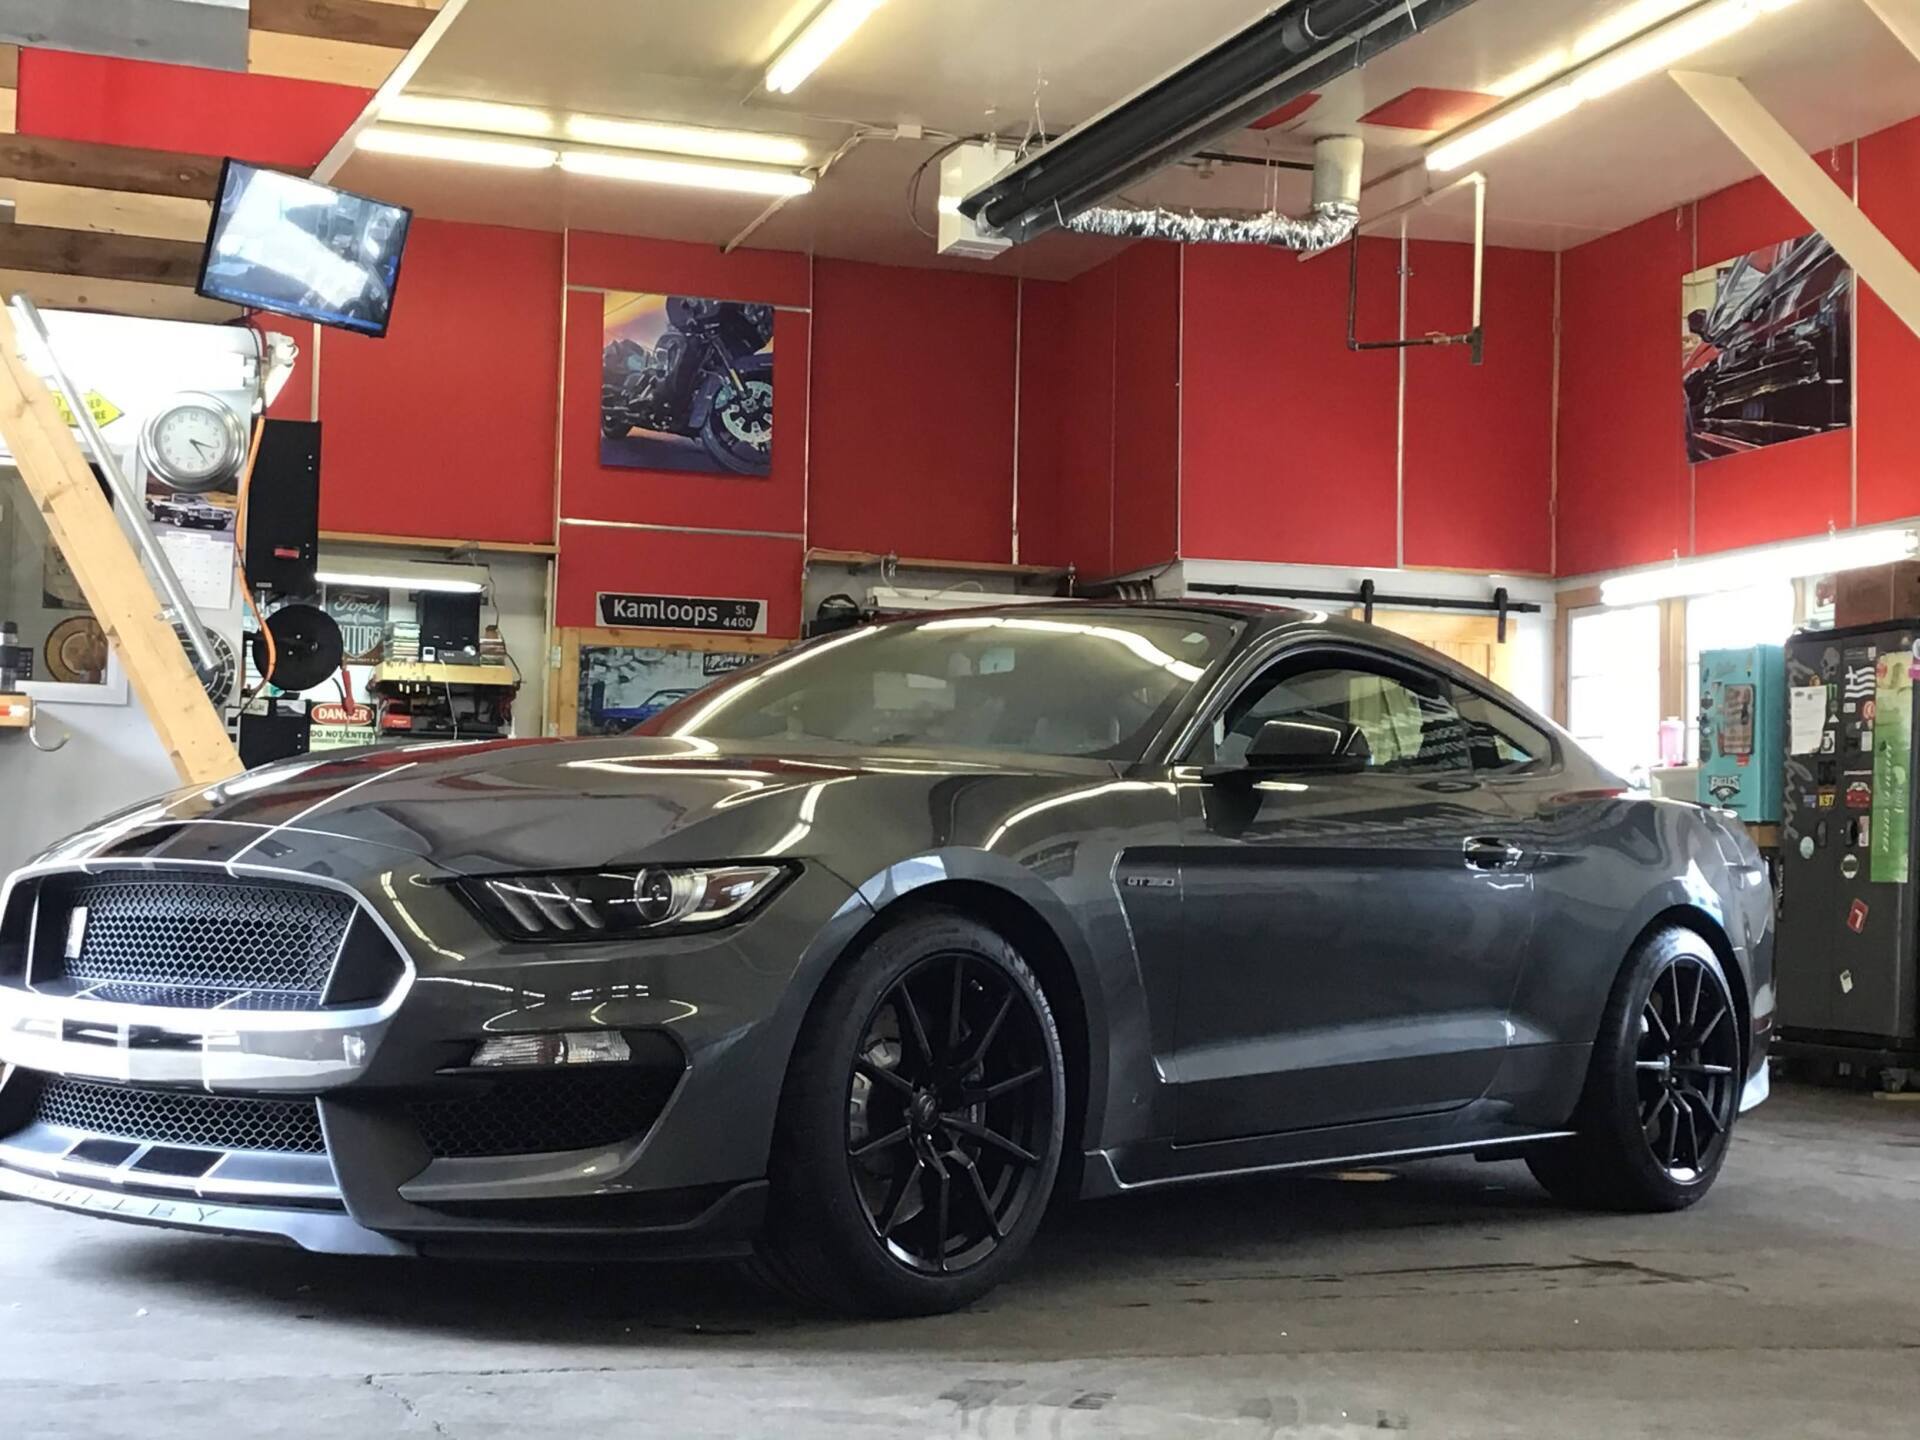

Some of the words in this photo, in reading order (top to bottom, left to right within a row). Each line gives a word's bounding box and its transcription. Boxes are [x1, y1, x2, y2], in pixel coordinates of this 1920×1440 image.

[334, 594, 381, 613] Ford
[614, 599, 718, 626] Kamloops
[736, 605, 747, 615] St
[723, 617, 753, 628] 4400
[338, 625, 382, 655] OTORS
[310, 730, 323, 738] DO
[326, 730, 343, 738] NOT
[27, 1182, 222, 1222] HLBY
